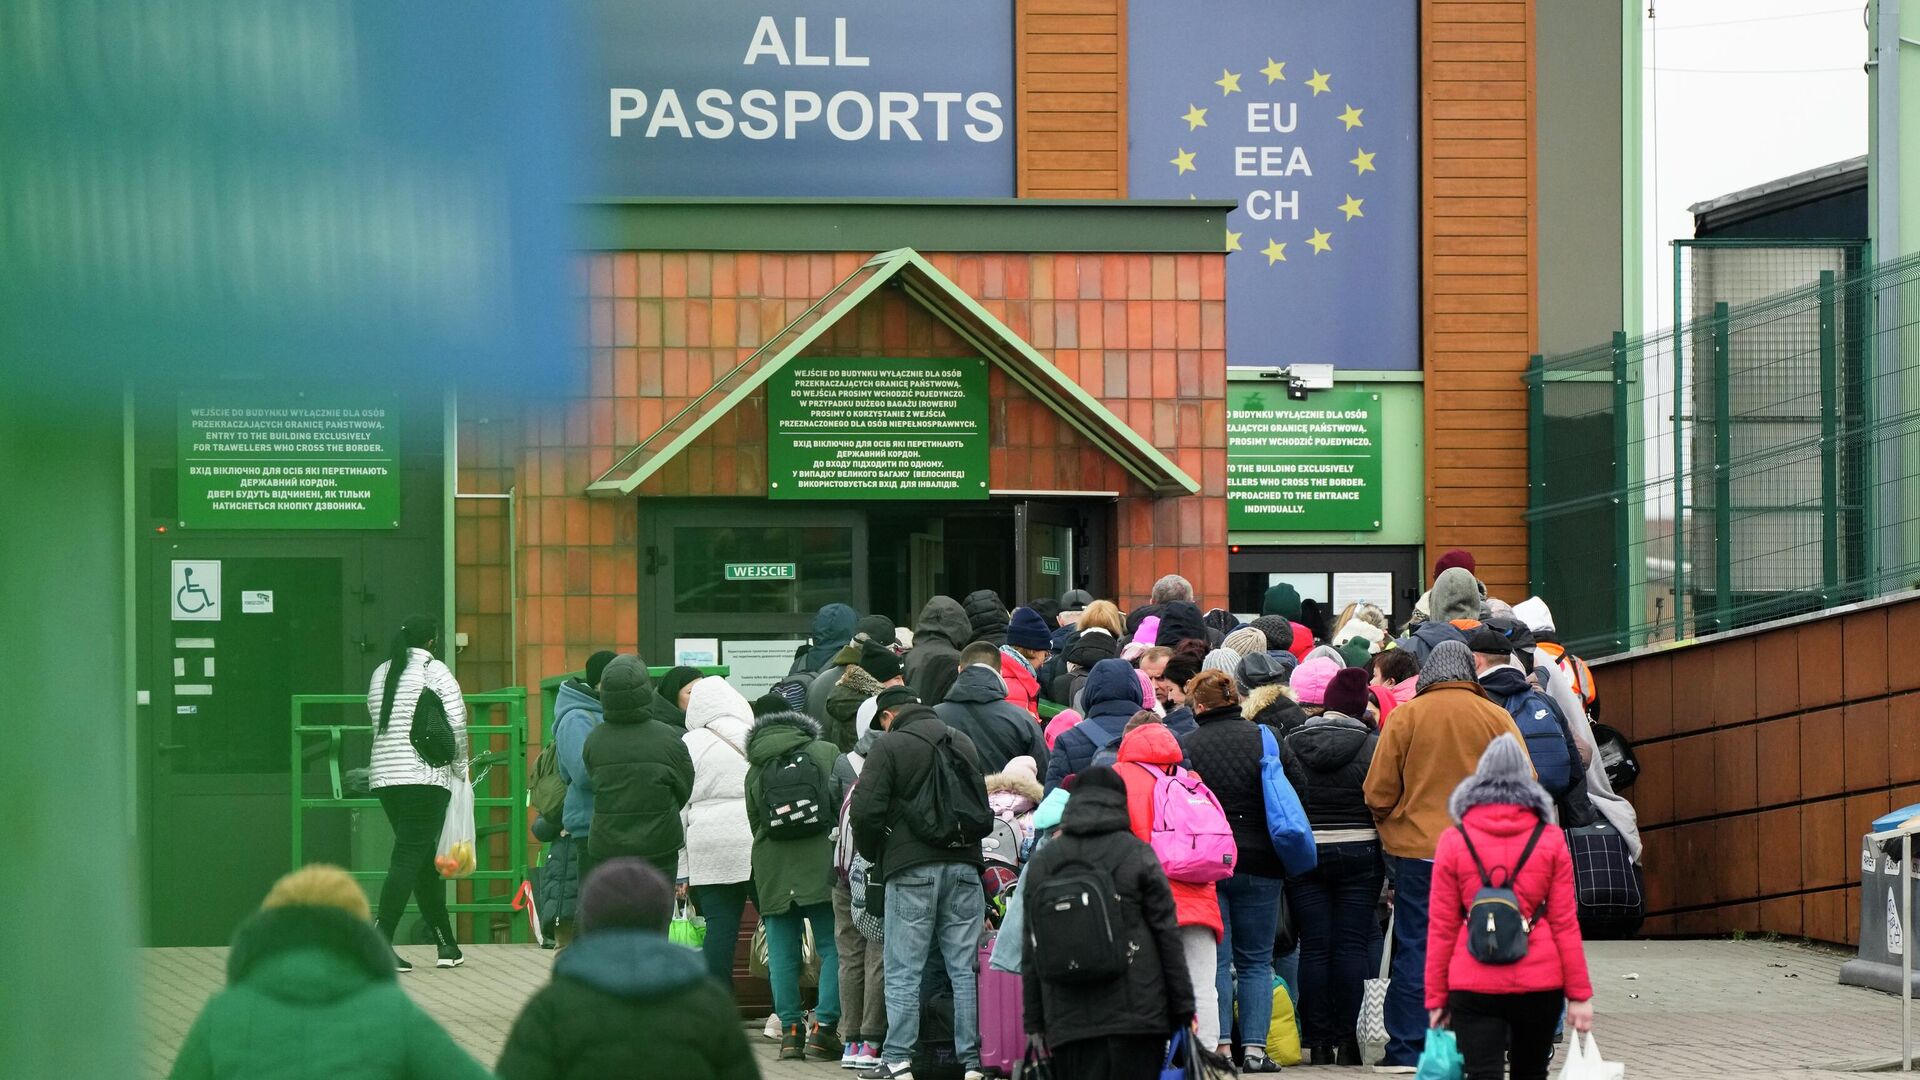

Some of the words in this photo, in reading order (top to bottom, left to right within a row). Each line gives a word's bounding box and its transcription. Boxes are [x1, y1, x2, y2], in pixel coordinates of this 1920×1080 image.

[743, 16, 870, 66] ALL
[610, 88, 1004, 142] PASSPORTS
[1247, 103, 1297, 133] EU
[1235, 147, 1312, 176] EEA
[1246, 190, 1299, 220] CH
[794, 368, 828, 377] WEJŚCIE
[879, 371, 924, 379] WYŁĄCZNIE
[941, 369, 962, 377] OSÓB
[796, 380, 873, 388] PRZEKRACZAJĄCYCH
[875, 381, 908, 389] GRANICĘ
[910, 379, 961, 389] PAŃSTWOWĄ.
[803, 388, 836, 397] WEJŚCIA
[874, 389, 913, 397] WCHODZIĆ
[855, 398, 885, 407] DUŻEGO
[887, 399, 917, 407] BAGAŻU
[191, 407, 230, 416] WEJŚCIE
[246, 409, 288, 417] BUDYNKU
[290, 410, 340, 418] WYŁĄCZNIE
[362, 408, 385, 417] OSÓB
[912, 409, 946, 417] WEJŚCIA
[1275, 411, 1325, 420] WYŁĄCZNIE
[1344, 409, 1368, 418] OSÓB
[192, 421, 282, 430] PRZEKRACZAJĄCYCH
[285, 421, 323, 430] GRANICĘ
[326, 419, 384, 430] PAŃSTWOWĄ.
[867, 419, 887, 427] OSÓB
[1227, 425, 1268, 434] ZAJĄCYCH
[1271, 425, 1307, 434] GRANICĘ
[1310, 423, 1366, 434] PAŃSTWOWĄ.
[270, 432, 311, 440] BUILDING
[314, 432, 370, 440] EXCLUSIVELY
[1269, 436, 1313, 445] WCHODZIĆ
[836, 449, 886, 458] ДЕРЖАВНИЙ
[190, 467, 211, 475] ВХІД
[262, 467, 281, 475] ДЛЯ
[240, 477, 298, 487] ДЕРЖАВНИЙ
[298, 479, 338, 487] КОРДОН.
[1227, 478, 1258, 486] ELLERS
[1260, 478, 1280, 486] WHO
[1282, 478, 1308, 486] CROSS
[1311, 478, 1327, 486] THE
[1330, 478, 1366, 486] BORDER.
[207, 491, 234, 499] ДВЕРІ
[236, 491, 270, 499] БУДУТЬ
[315, 502, 365, 511] ДЗВОНИКА.
[1244, 505, 1306, 513] INDIVIDUALLY.
